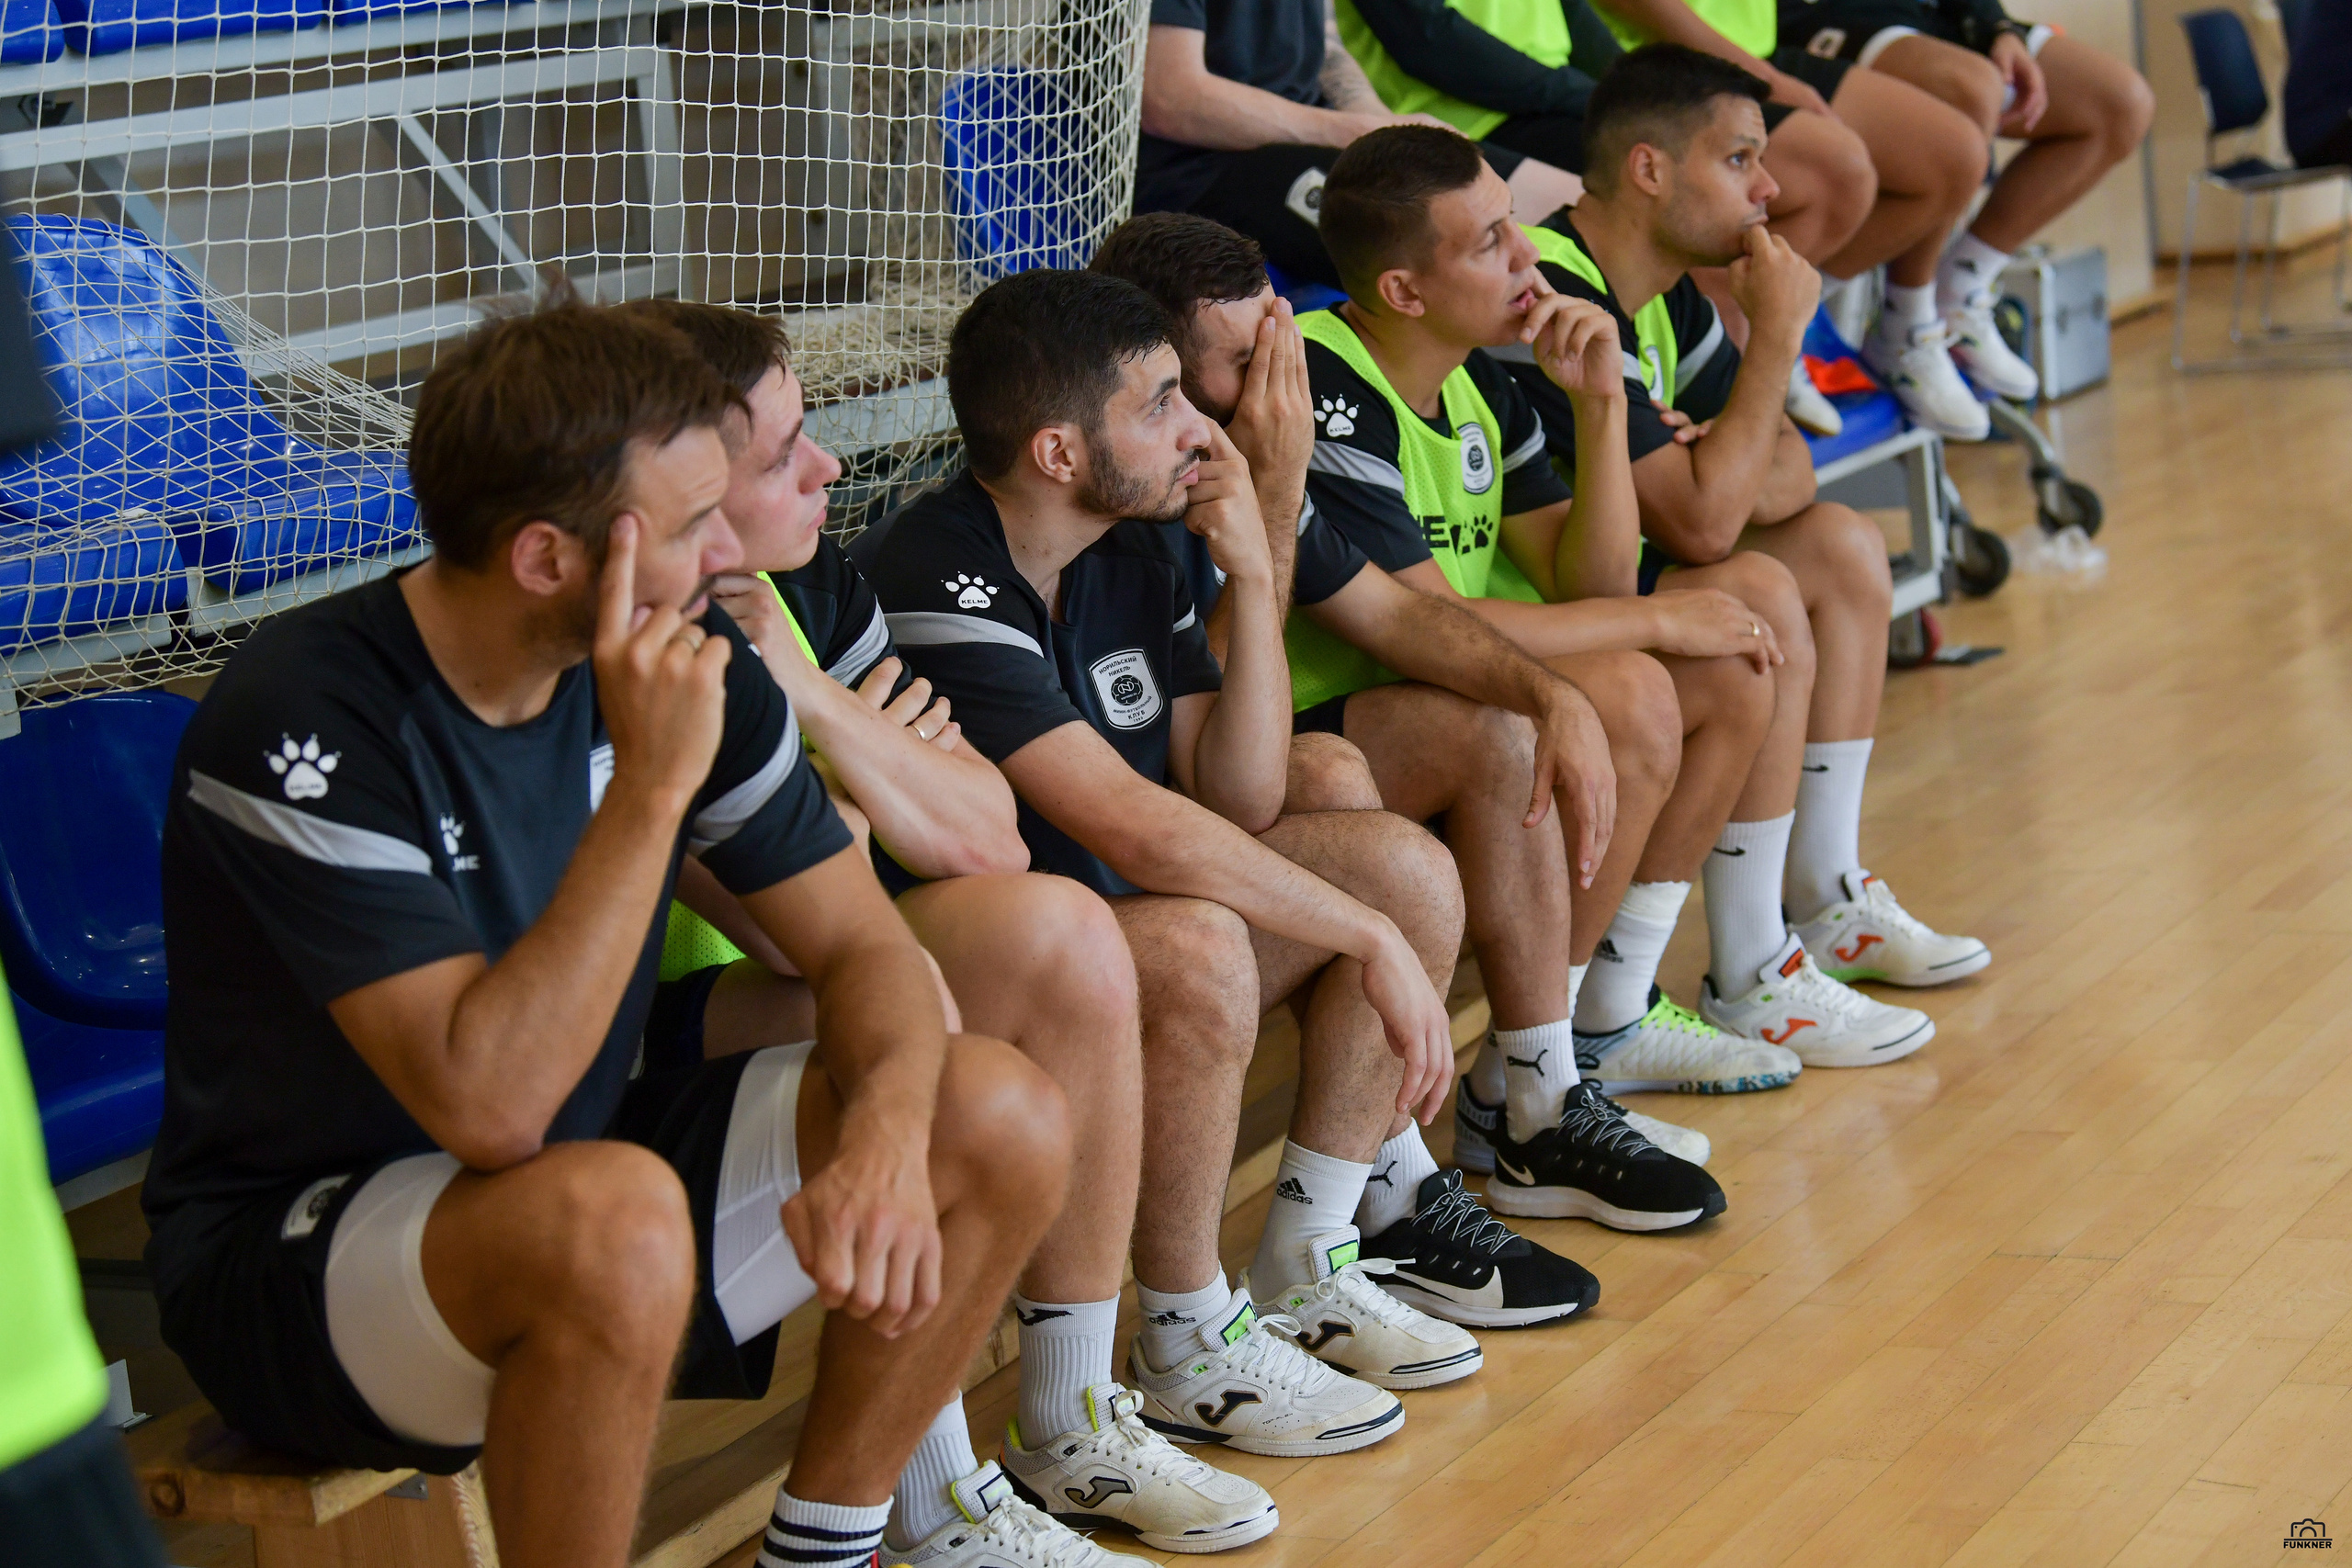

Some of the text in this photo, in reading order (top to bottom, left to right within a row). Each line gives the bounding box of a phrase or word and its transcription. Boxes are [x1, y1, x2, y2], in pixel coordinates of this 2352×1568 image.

[1098, 656, 1137, 674] НОРИЛЬСКИЙ
[1108, 665, 1131, 677] НИКЕЛЬ
[1127, 710, 1146, 720] КЛУБ
[1277, 1188, 1313, 1204] adidas
[1149, 1316, 1196, 1326] adidas
